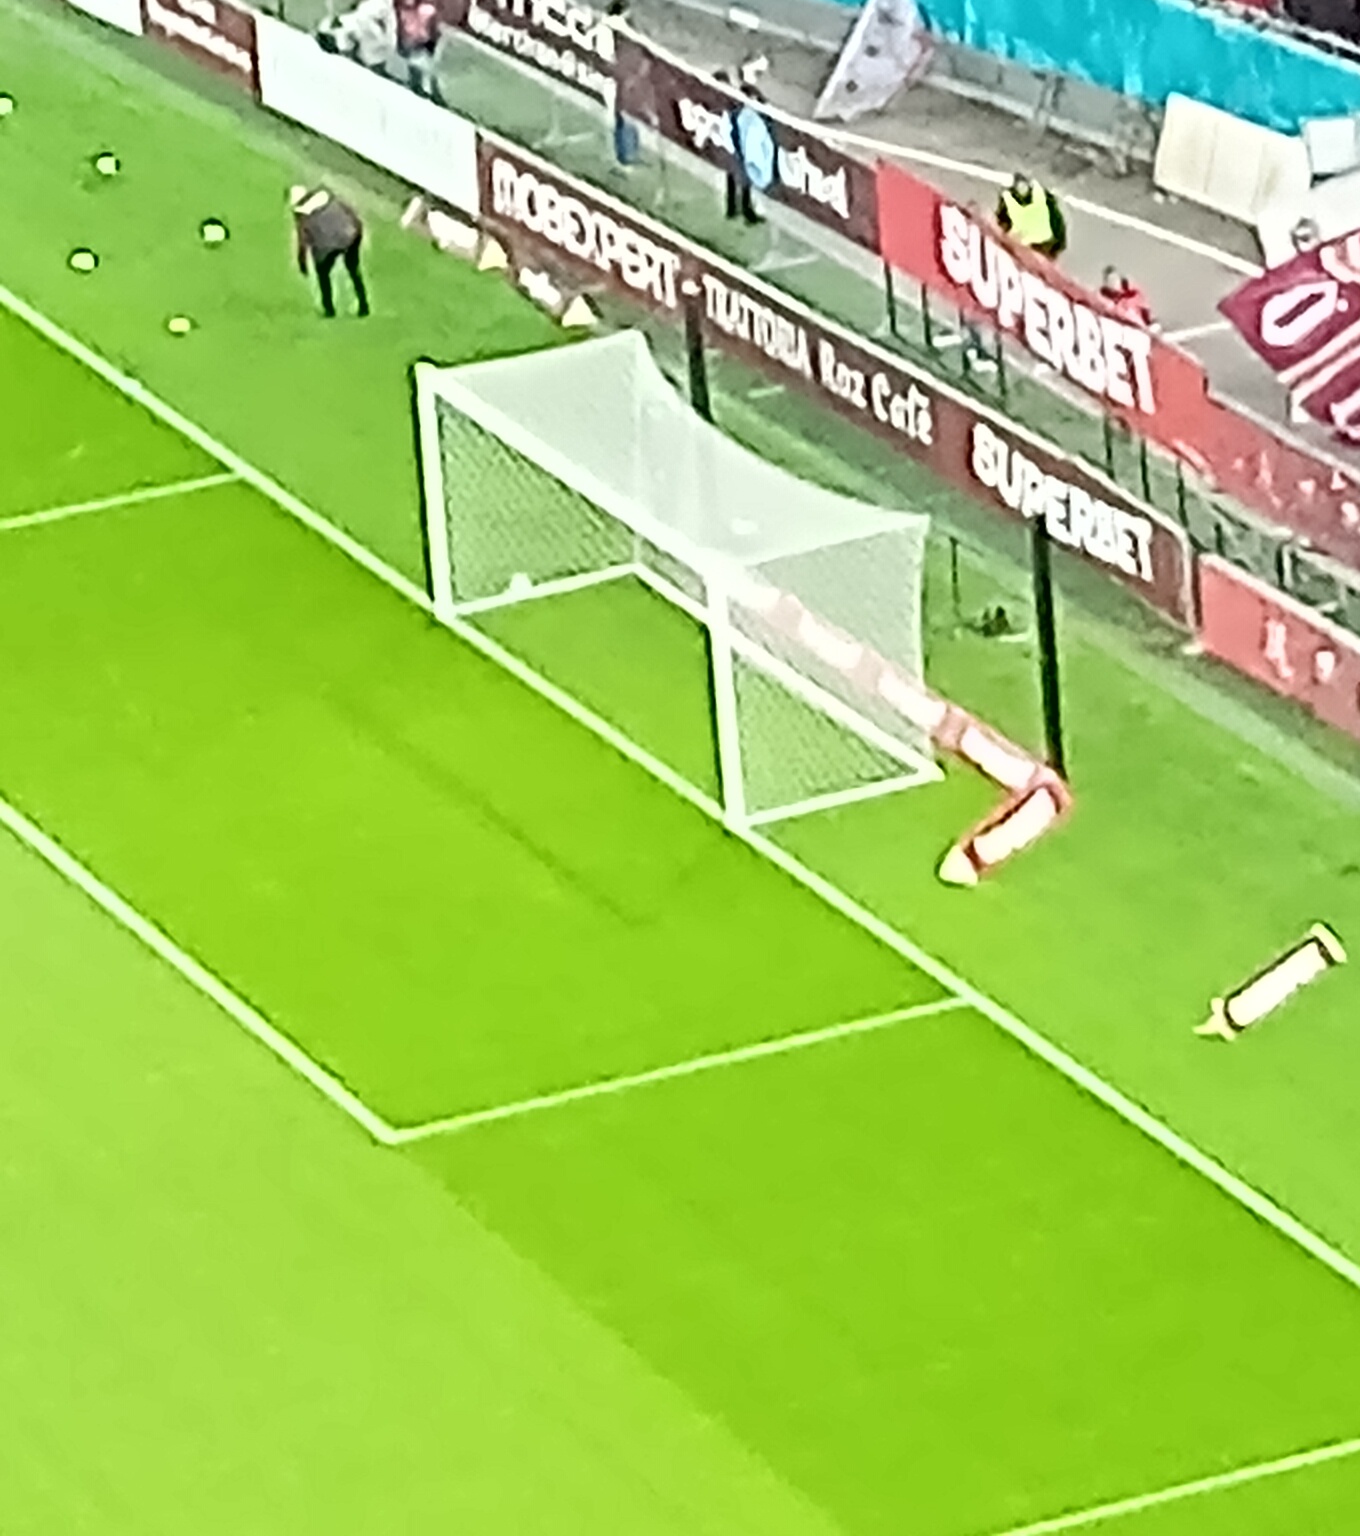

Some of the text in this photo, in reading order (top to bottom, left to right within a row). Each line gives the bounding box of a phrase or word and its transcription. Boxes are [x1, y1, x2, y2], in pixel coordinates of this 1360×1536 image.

[819, 342, 868, 409] Roz
[940, 202, 1156, 415] SUPERBET
[971, 422, 1154, 584] SUPERBET
